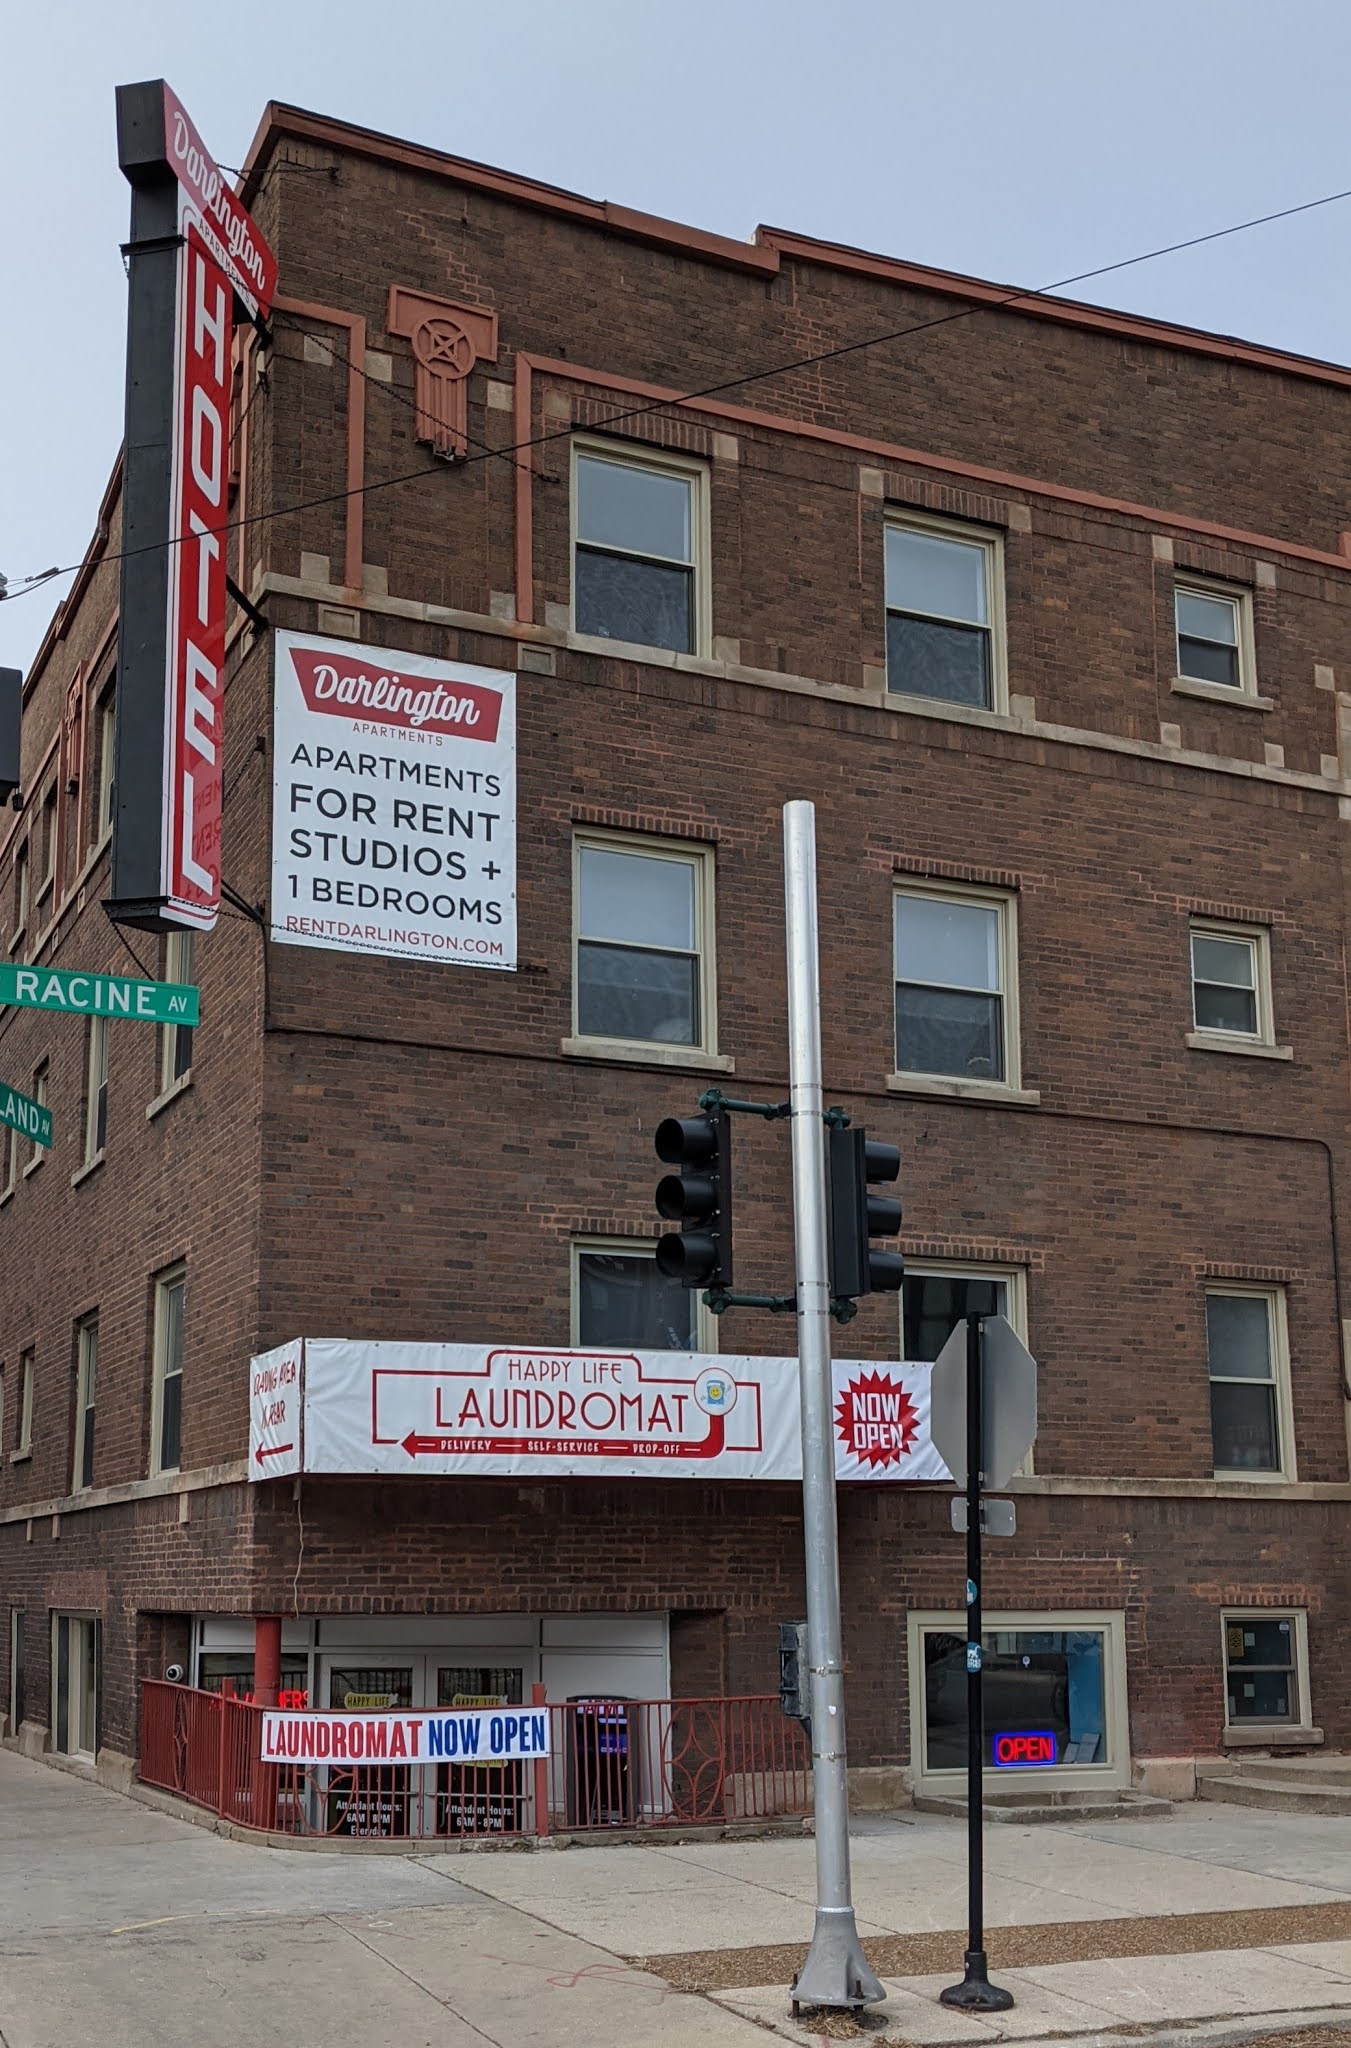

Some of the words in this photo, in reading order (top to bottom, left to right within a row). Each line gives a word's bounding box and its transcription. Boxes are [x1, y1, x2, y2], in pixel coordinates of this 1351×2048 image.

[174, 111, 266, 290] Darlington
[199, 218, 250, 303] APARTMENTS
[182, 252, 226, 897] HOTEL
[312, 664, 480, 727] Darlington
[352, 721, 443, 747] APARTMENTS
[290, 743, 502, 797] APARTMENTS
[289, 783, 377, 825] FOR
[393, 798, 501, 842] RENT
[289, 828, 467, 880] STUDIOS
[481, 860, 502, 881] +
[288, 873, 299, 899] 1
[312, 877, 503, 925] BEDROOMS
[286, 914, 503, 956] RENTDARLINGTON.COM
[16, 970, 157, 1016] RACINE
[168, 995, 188, 1013] AV
[508, 1358, 571, 1383] HAPPY
[583, 1361, 622, 1385] LIFE
[436, 1387, 689, 1433] LAUNDROMAT
[852, 1392, 901, 1422] NOW
[440, 1440, 492, 1451] DELIVERY
[527, 1440, 600, 1453] SELF-SERVICE
[632, 1443, 681, 1455] DROP-OFF
[853, 1423, 904, 1449] OPEN
[347, 1695, 370, 1708] HAPPY
[374, 1695, 390, 1708] LIFE
[266, 1719, 423, 1759] LAUNDROMAT
[428, 1718, 481, 1757] NOW
[490, 1715, 546, 1754] OPEN
[998, 1736, 1054, 1763] OPEN
[335, 1800, 375, 1811] Attndat
[376, 1801, 402, 1812] Hous:
[445, 1803, 486, 1815] Attendnt
[350, 1825, 388, 1837] Eerydy
